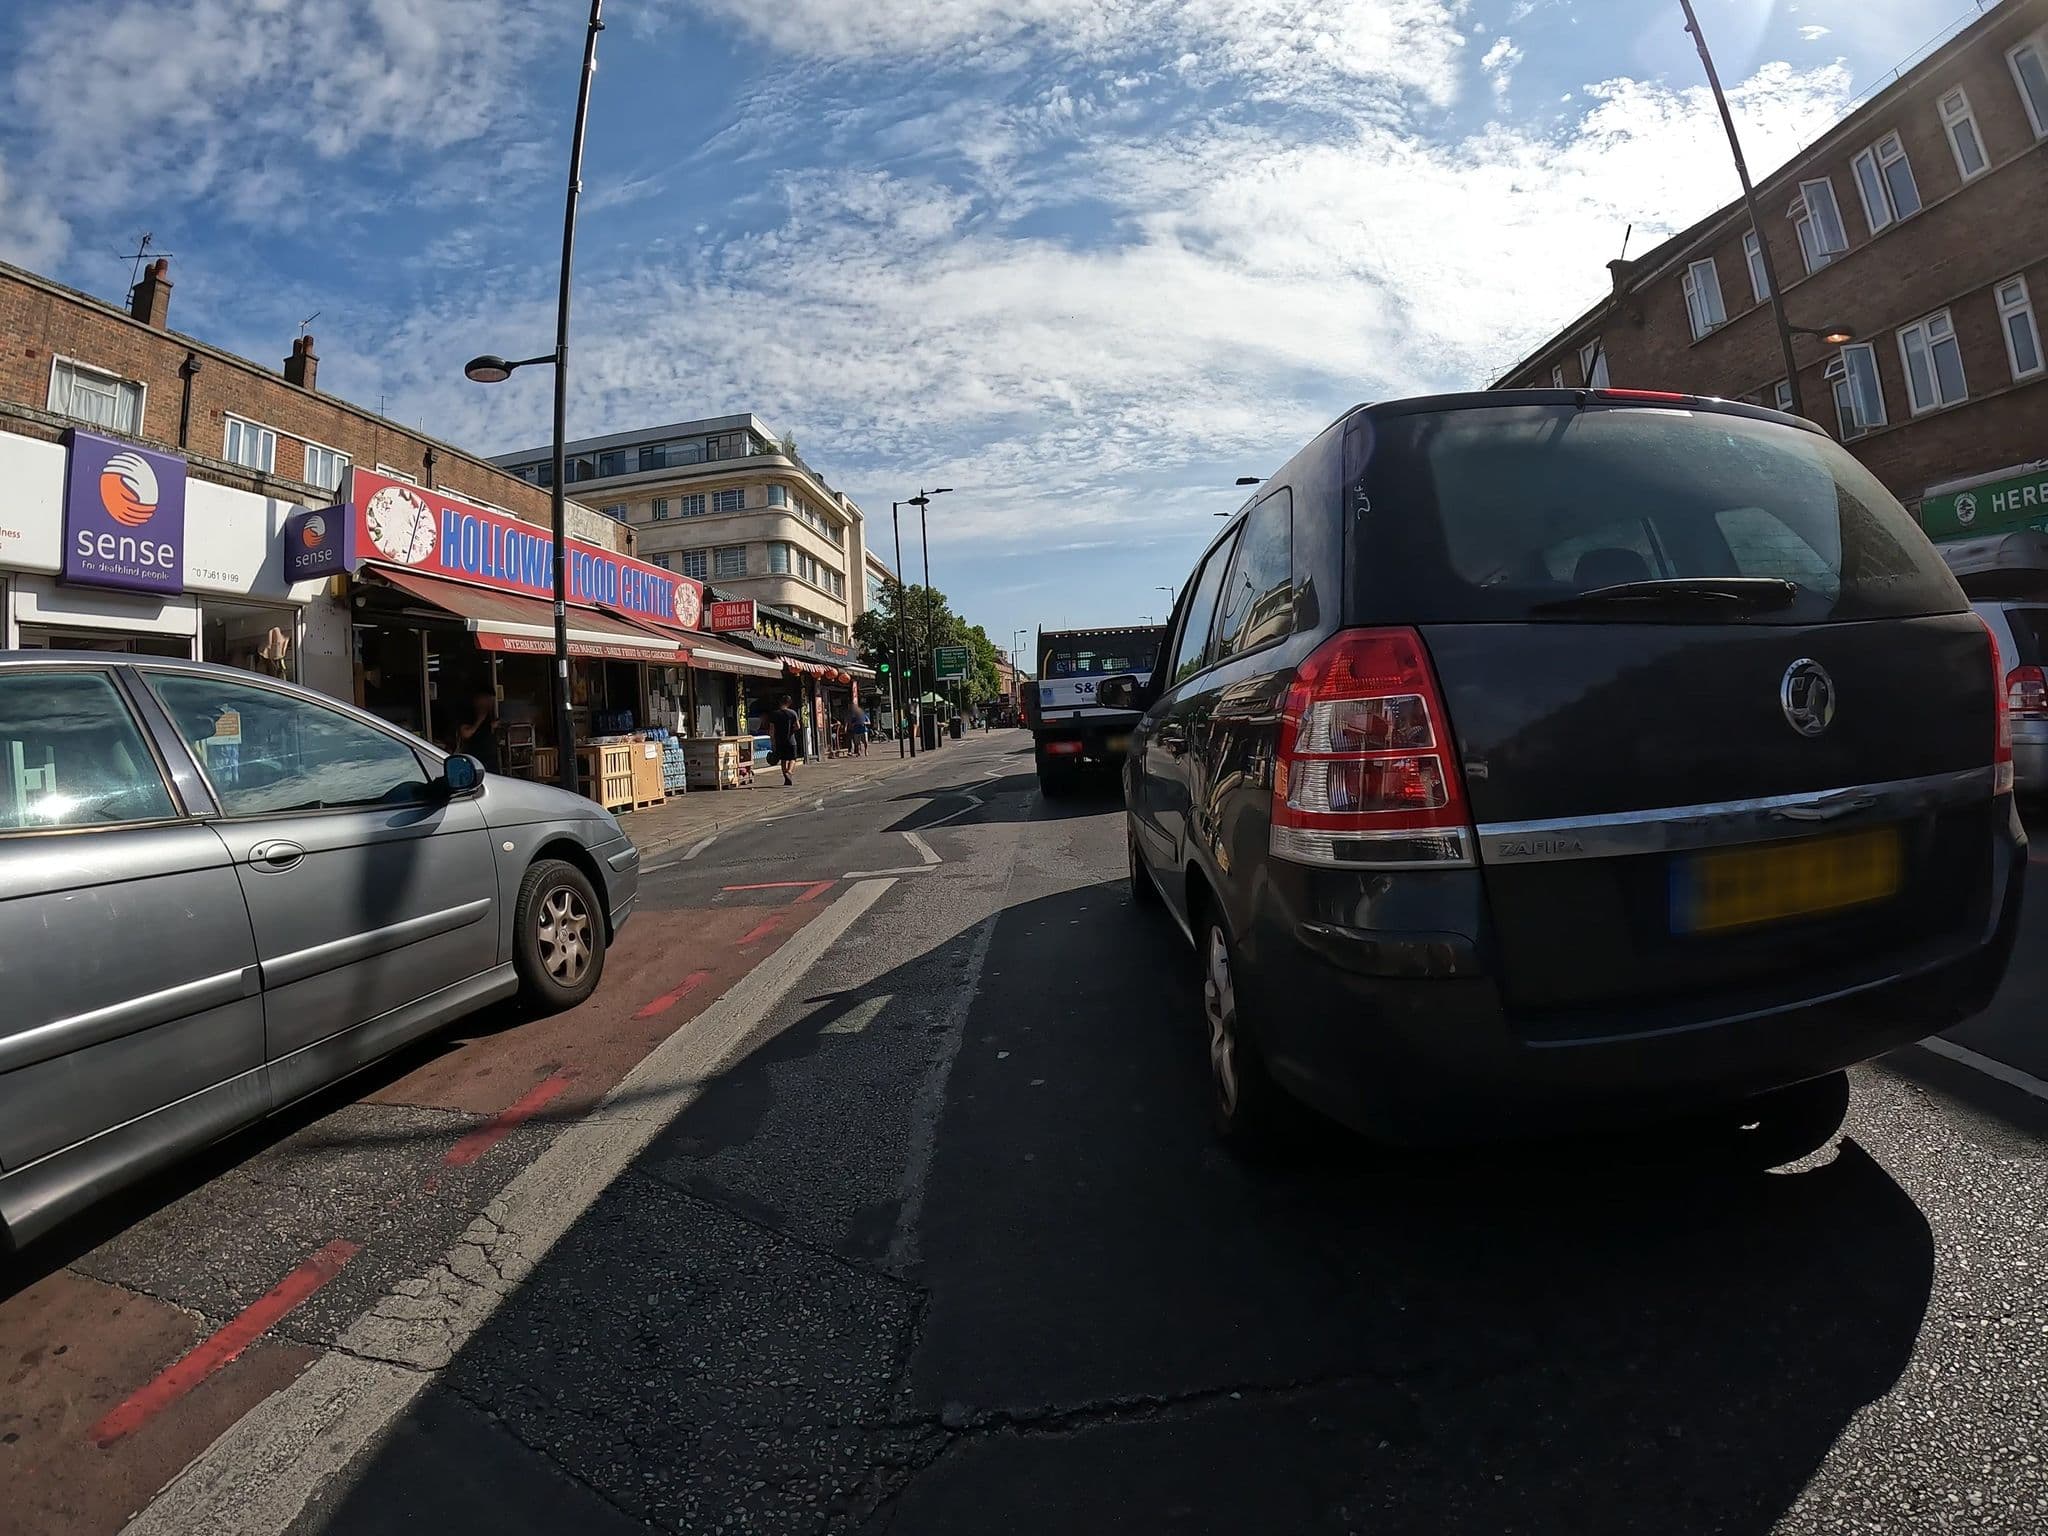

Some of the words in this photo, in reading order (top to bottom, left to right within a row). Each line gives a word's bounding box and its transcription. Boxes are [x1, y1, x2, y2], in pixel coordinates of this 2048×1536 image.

[77, 530, 174, 568] sense
[295, 549, 332, 567] sense
[440, 507, 566, 590] HOLLOWA
[571, 549, 617, 606] FOOD
[620, 565, 673, 618] CENTRE
[82, 560, 96, 570] For
[98, 562, 139, 576] deafblind
[726, 603, 751, 615] HALAL
[714, 615, 751, 627] BUTCHERS
[503, 638, 556, 651] INTERNATIONA
[567, 643, 579, 652] PER
[1499, 840, 1584, 856] ZAFIRA
